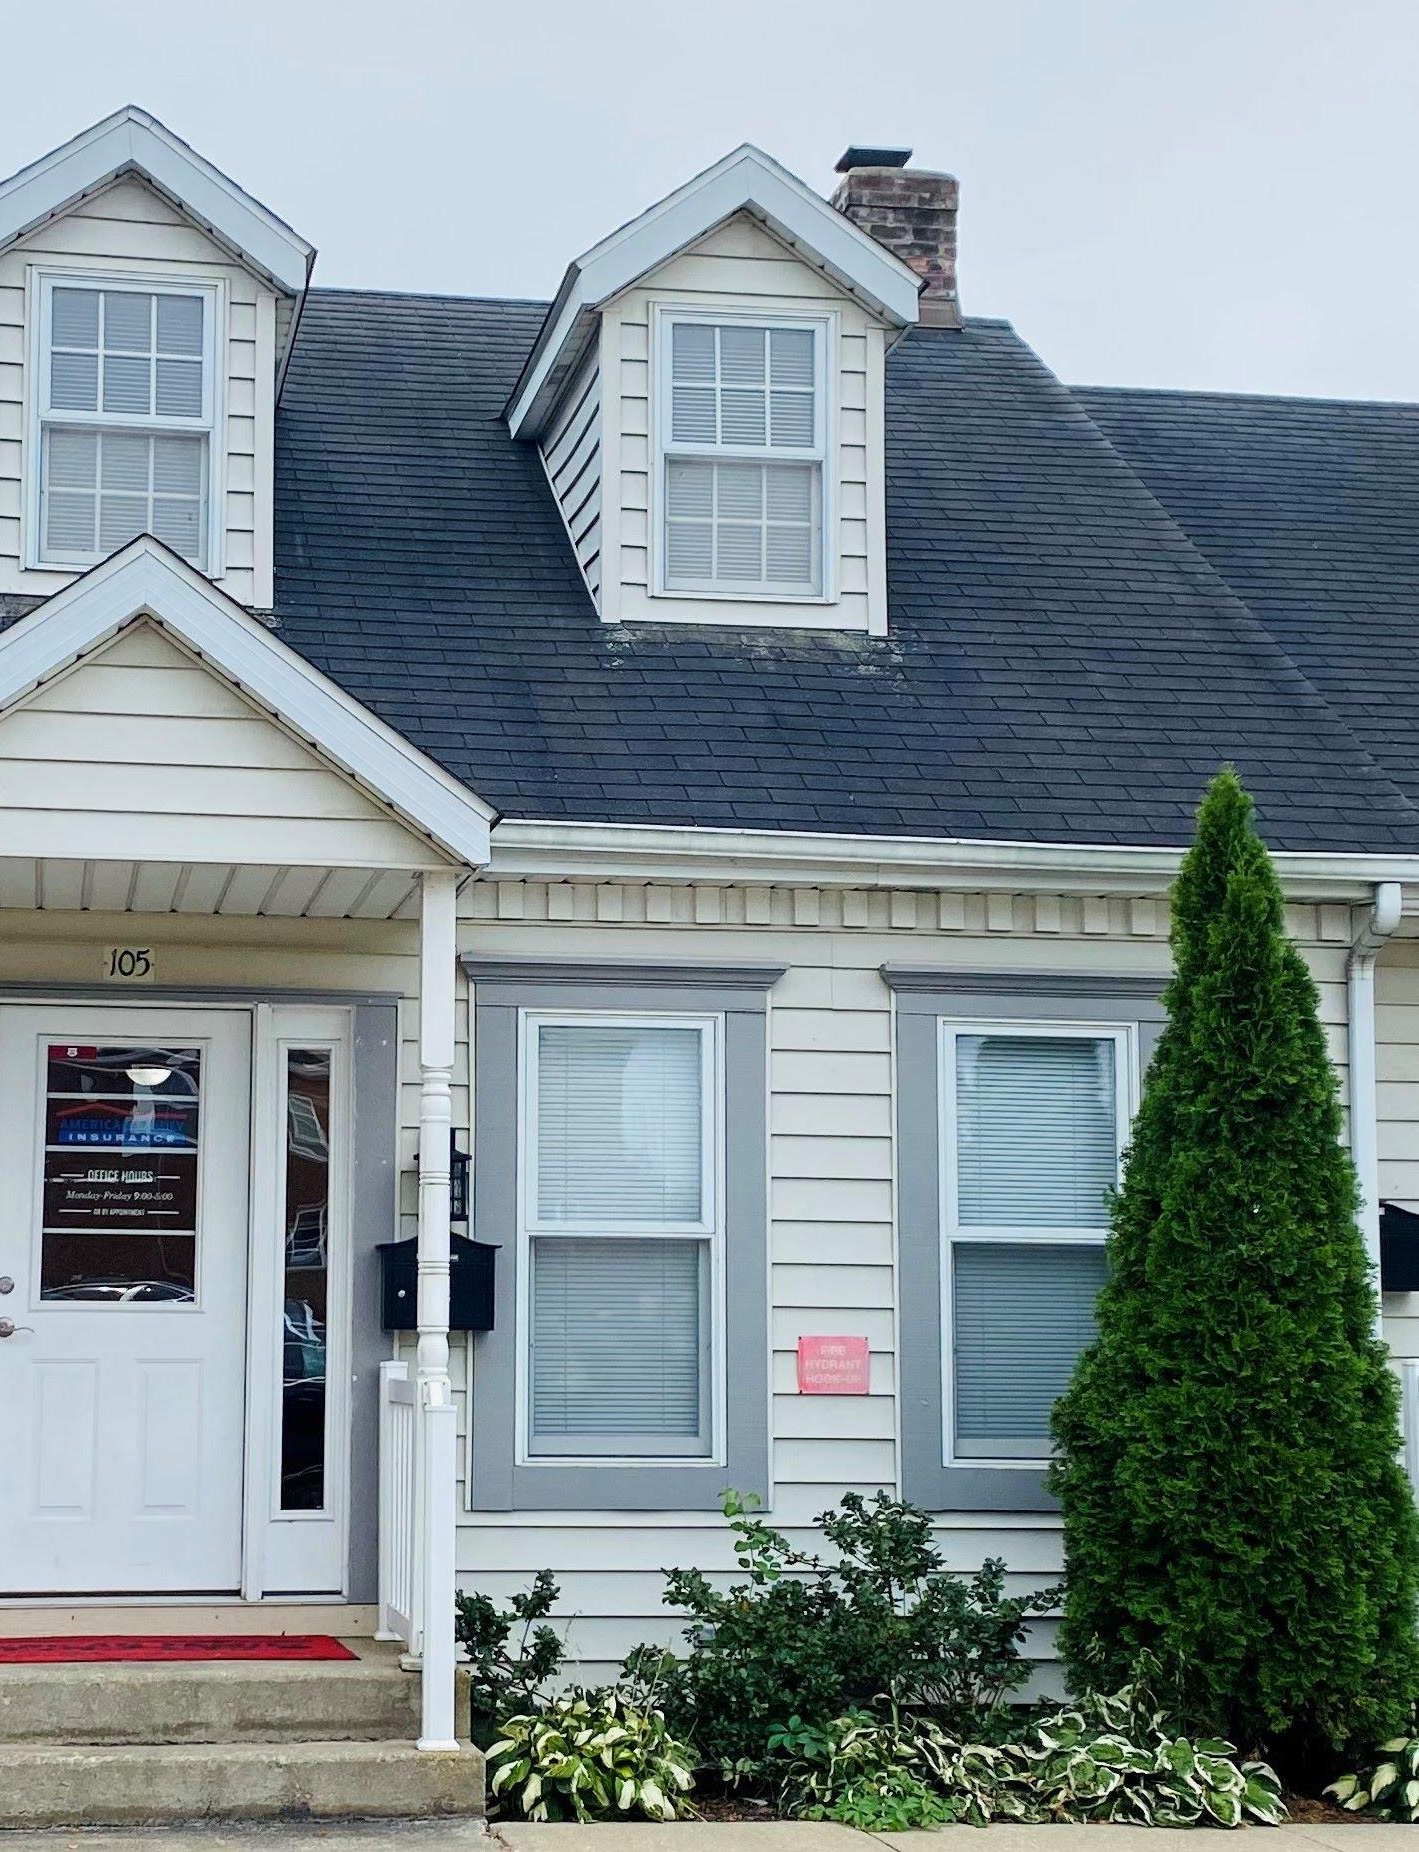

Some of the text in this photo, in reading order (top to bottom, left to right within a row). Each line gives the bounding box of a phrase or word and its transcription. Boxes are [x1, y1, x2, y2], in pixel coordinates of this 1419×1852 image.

[109, 948, 151, 977] 105
[87, 1169, 154, 1183] OFFICE HOURS
[804, 1360, 862, 1370] HYDRANT
